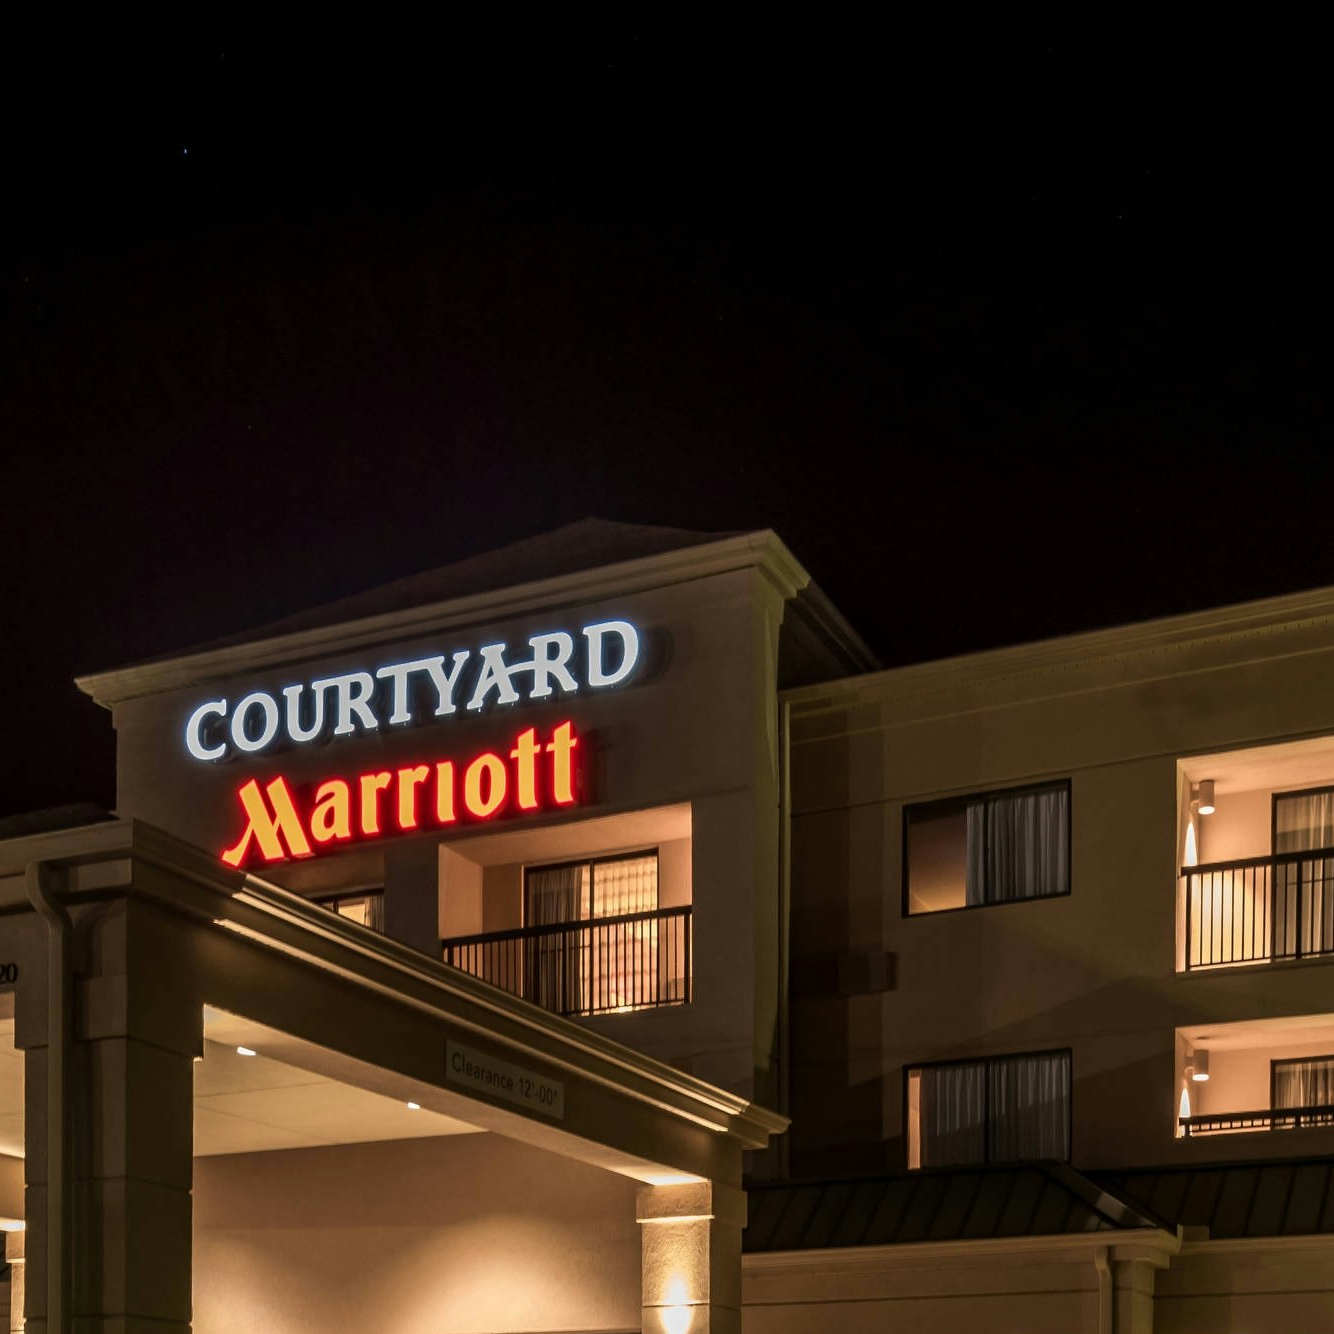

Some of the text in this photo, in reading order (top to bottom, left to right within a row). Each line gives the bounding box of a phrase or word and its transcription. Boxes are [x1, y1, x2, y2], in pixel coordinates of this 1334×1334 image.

[185, 619, 640, 761] COURTYARD
[220, 720, 578, 868] Marriott
[452, 1051, 514, 1091] Clearance
